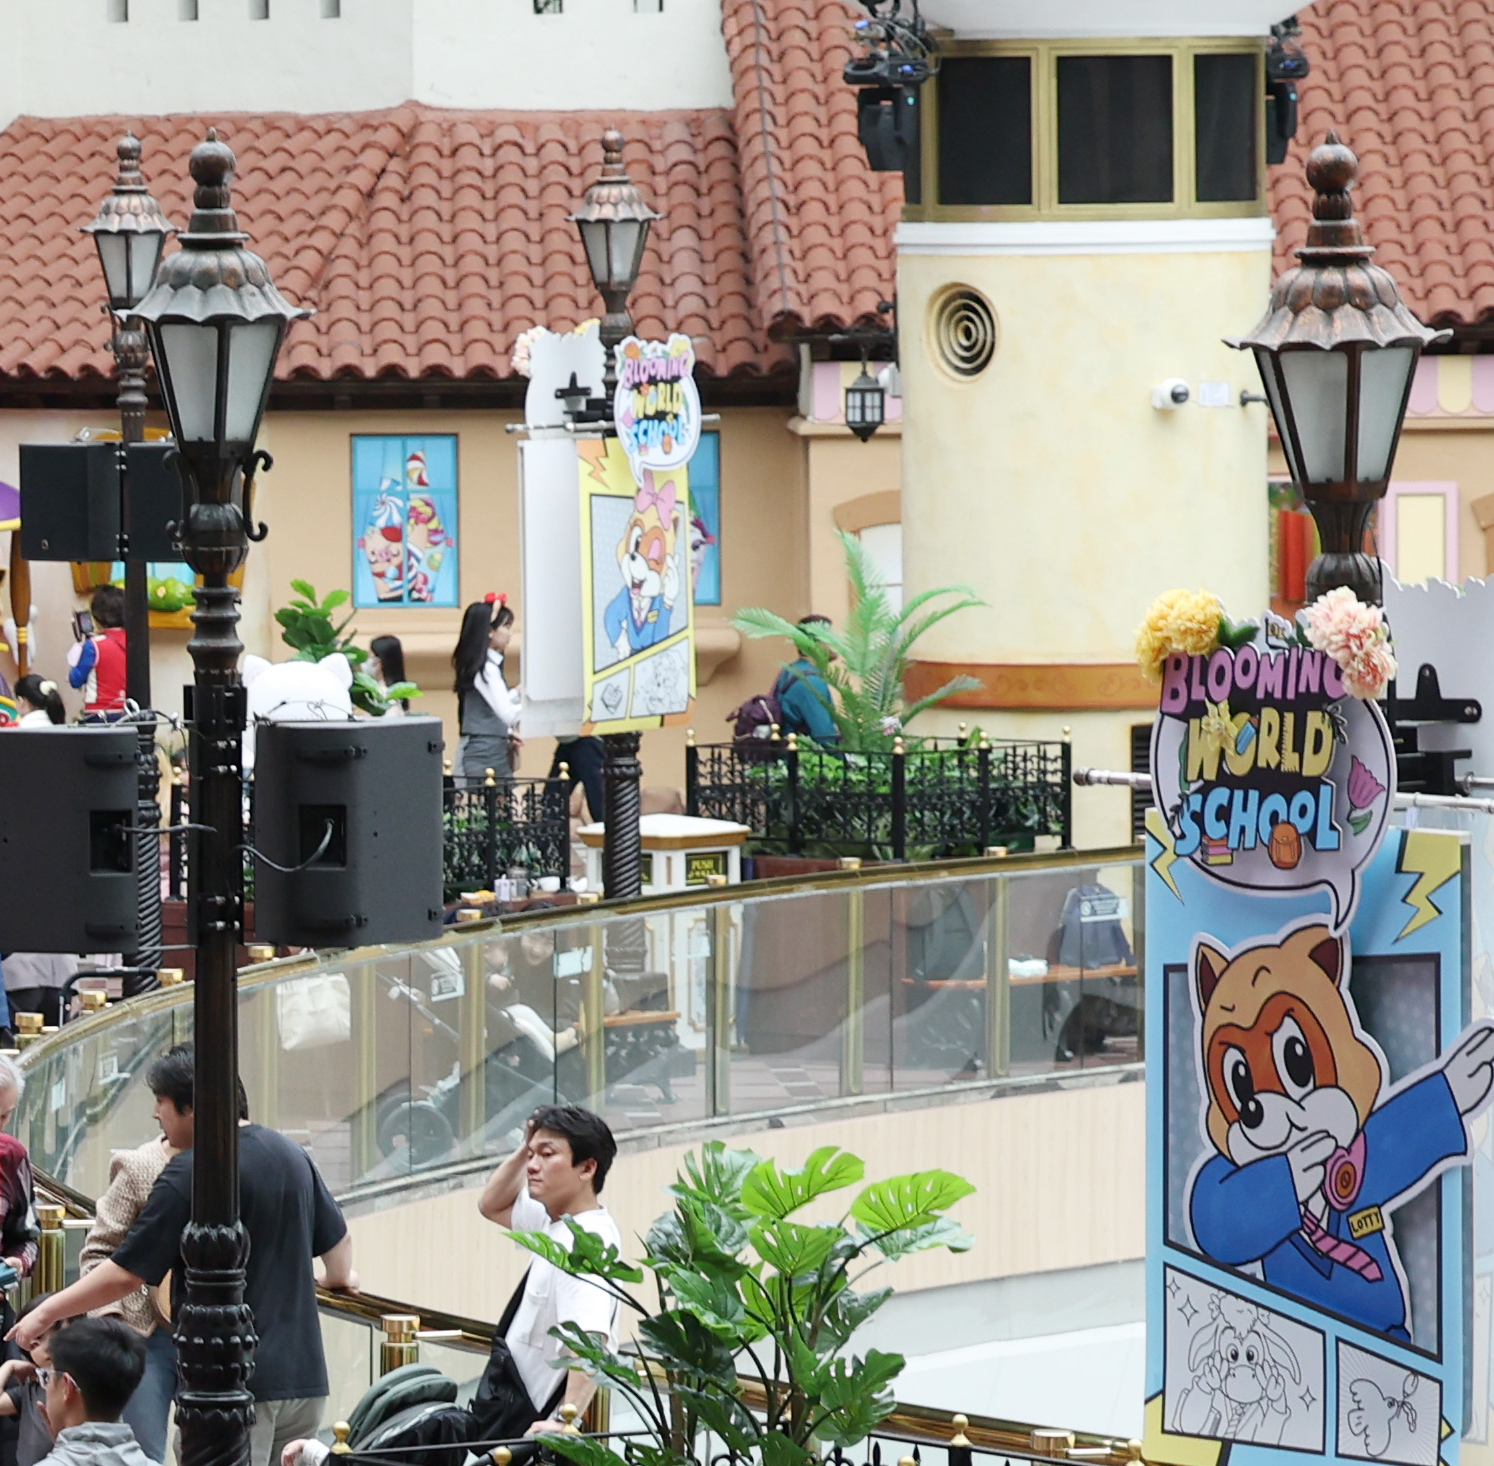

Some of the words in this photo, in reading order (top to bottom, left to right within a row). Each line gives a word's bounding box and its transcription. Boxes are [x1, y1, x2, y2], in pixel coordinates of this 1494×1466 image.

[632, 382, 683, 419] WORLD
[628, 415, 687, 453] SCHOOL
[1186, 706, 1335, 782] WORLD
[1174, 785, 1341, 856] SCHOOL
[1350, 1211, 1380, 1233] LOTTY
